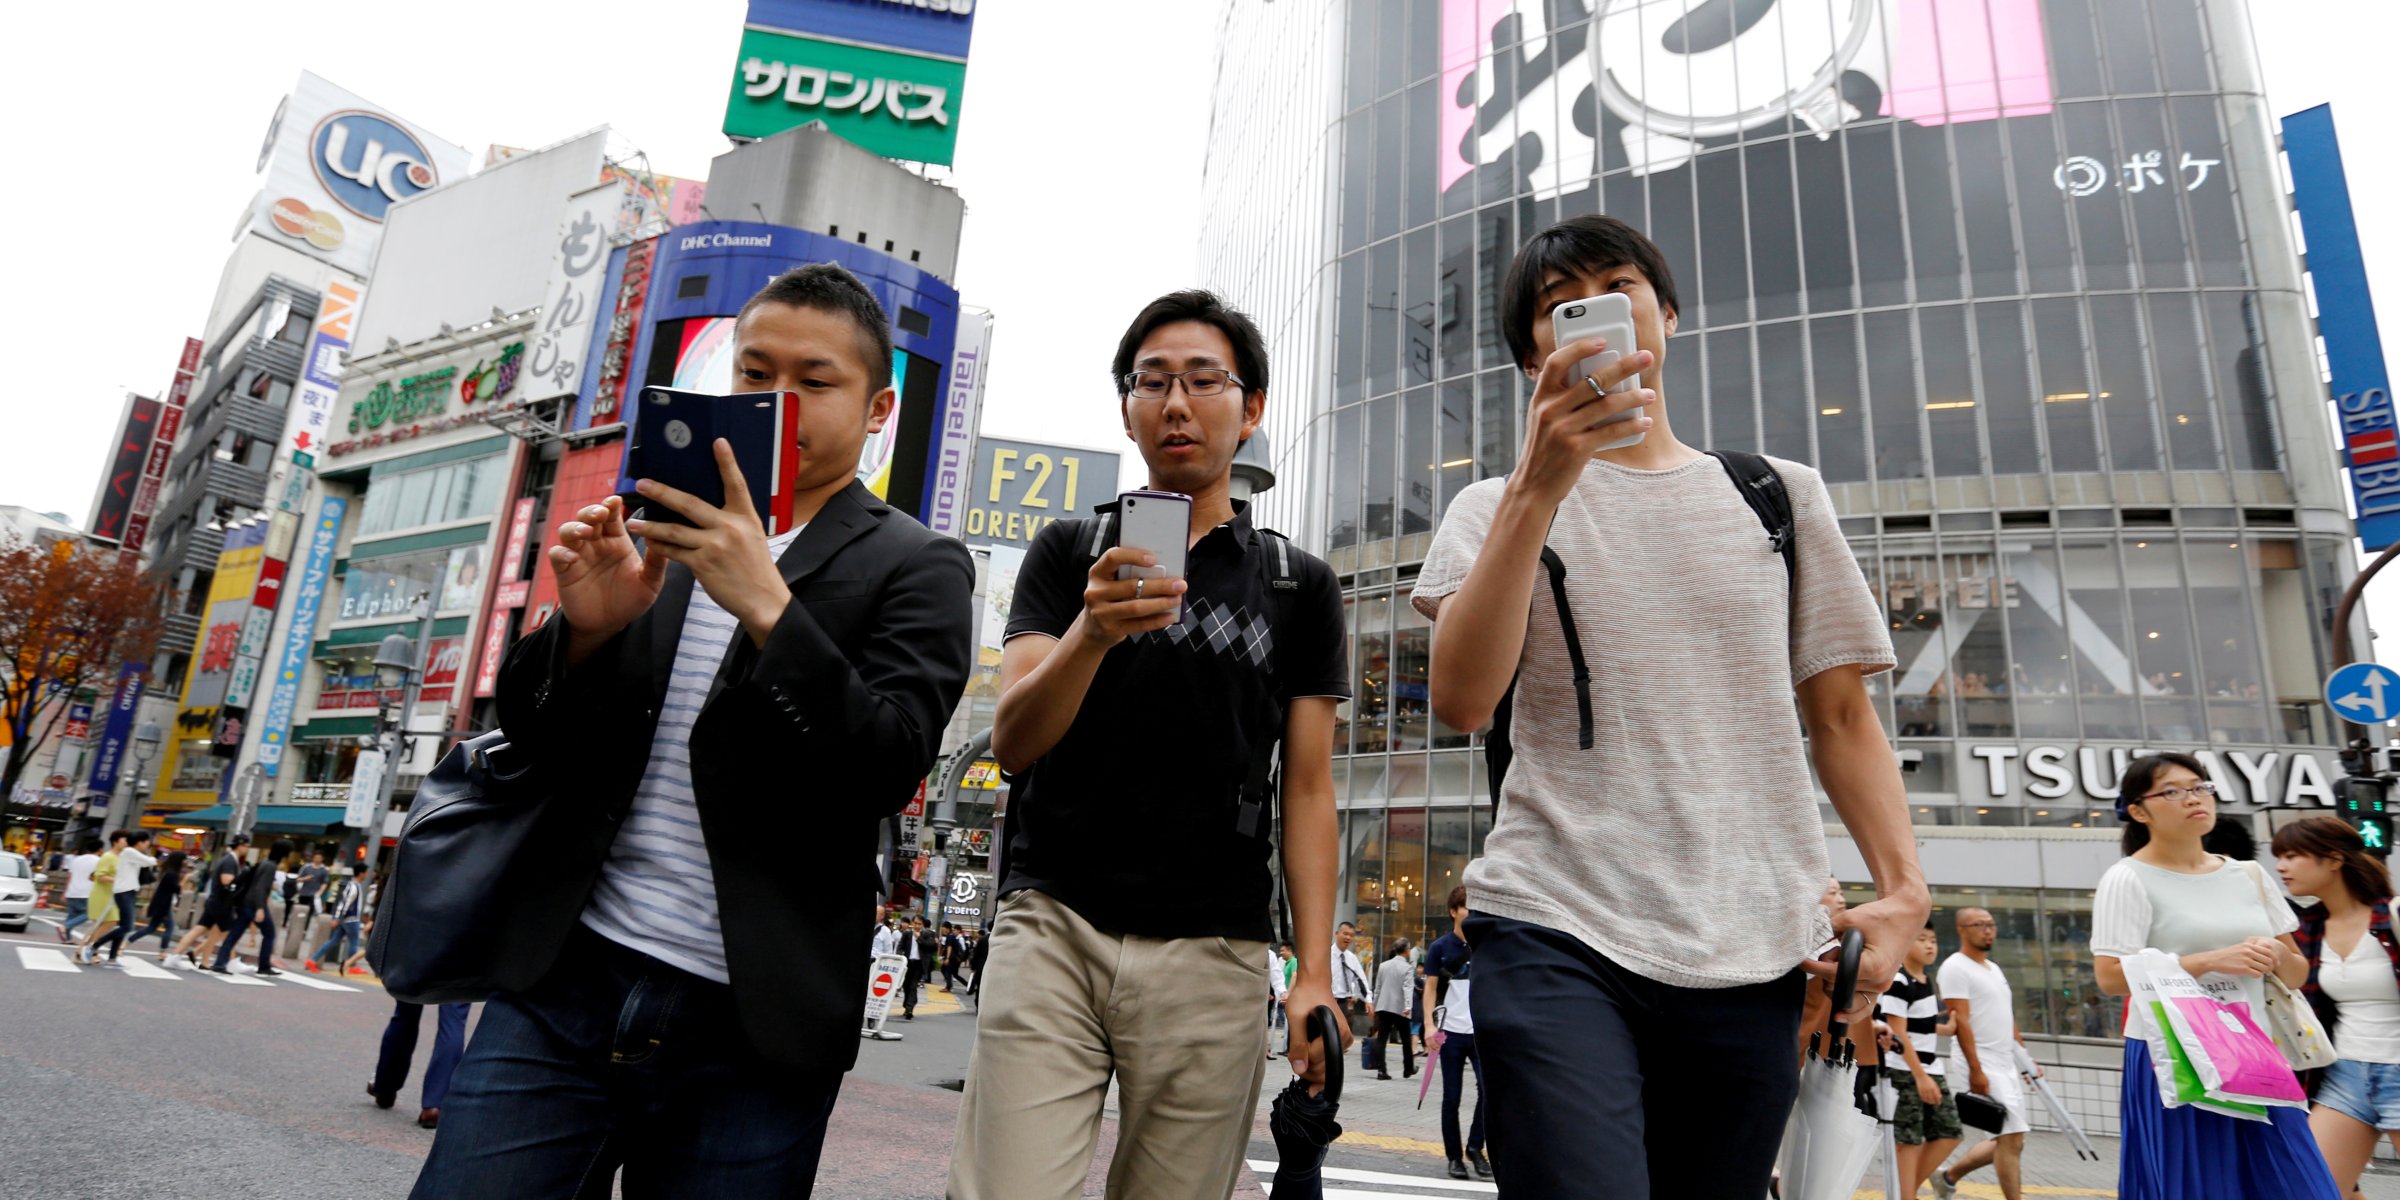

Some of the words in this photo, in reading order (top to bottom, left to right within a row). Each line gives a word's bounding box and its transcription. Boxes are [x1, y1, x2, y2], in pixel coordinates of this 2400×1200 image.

[741, 57, 948, 126] サロンパス
[2114, 150, 2220, 193] ポケ
[681, 235, 711, 250] DHC
[713, 233, 771, 248] Channel
[531, 210, 604, 388] もんじゃ
[946, 345, 979, 440] Taisei
[988, 447, 1080, 511] F21
[2340, 388, 2400, 518] SEIBU
[933, 450, 960, 532] neon
[287, 530, 334, 668] サマーフルーツギフト
[426, 646, 464, 677] JTB
[1973, 746, 2336, 806] TSUAYA
[902, 817, 918, 845] 牛繁
[944, 905, 980, 916] IS'DEMO
